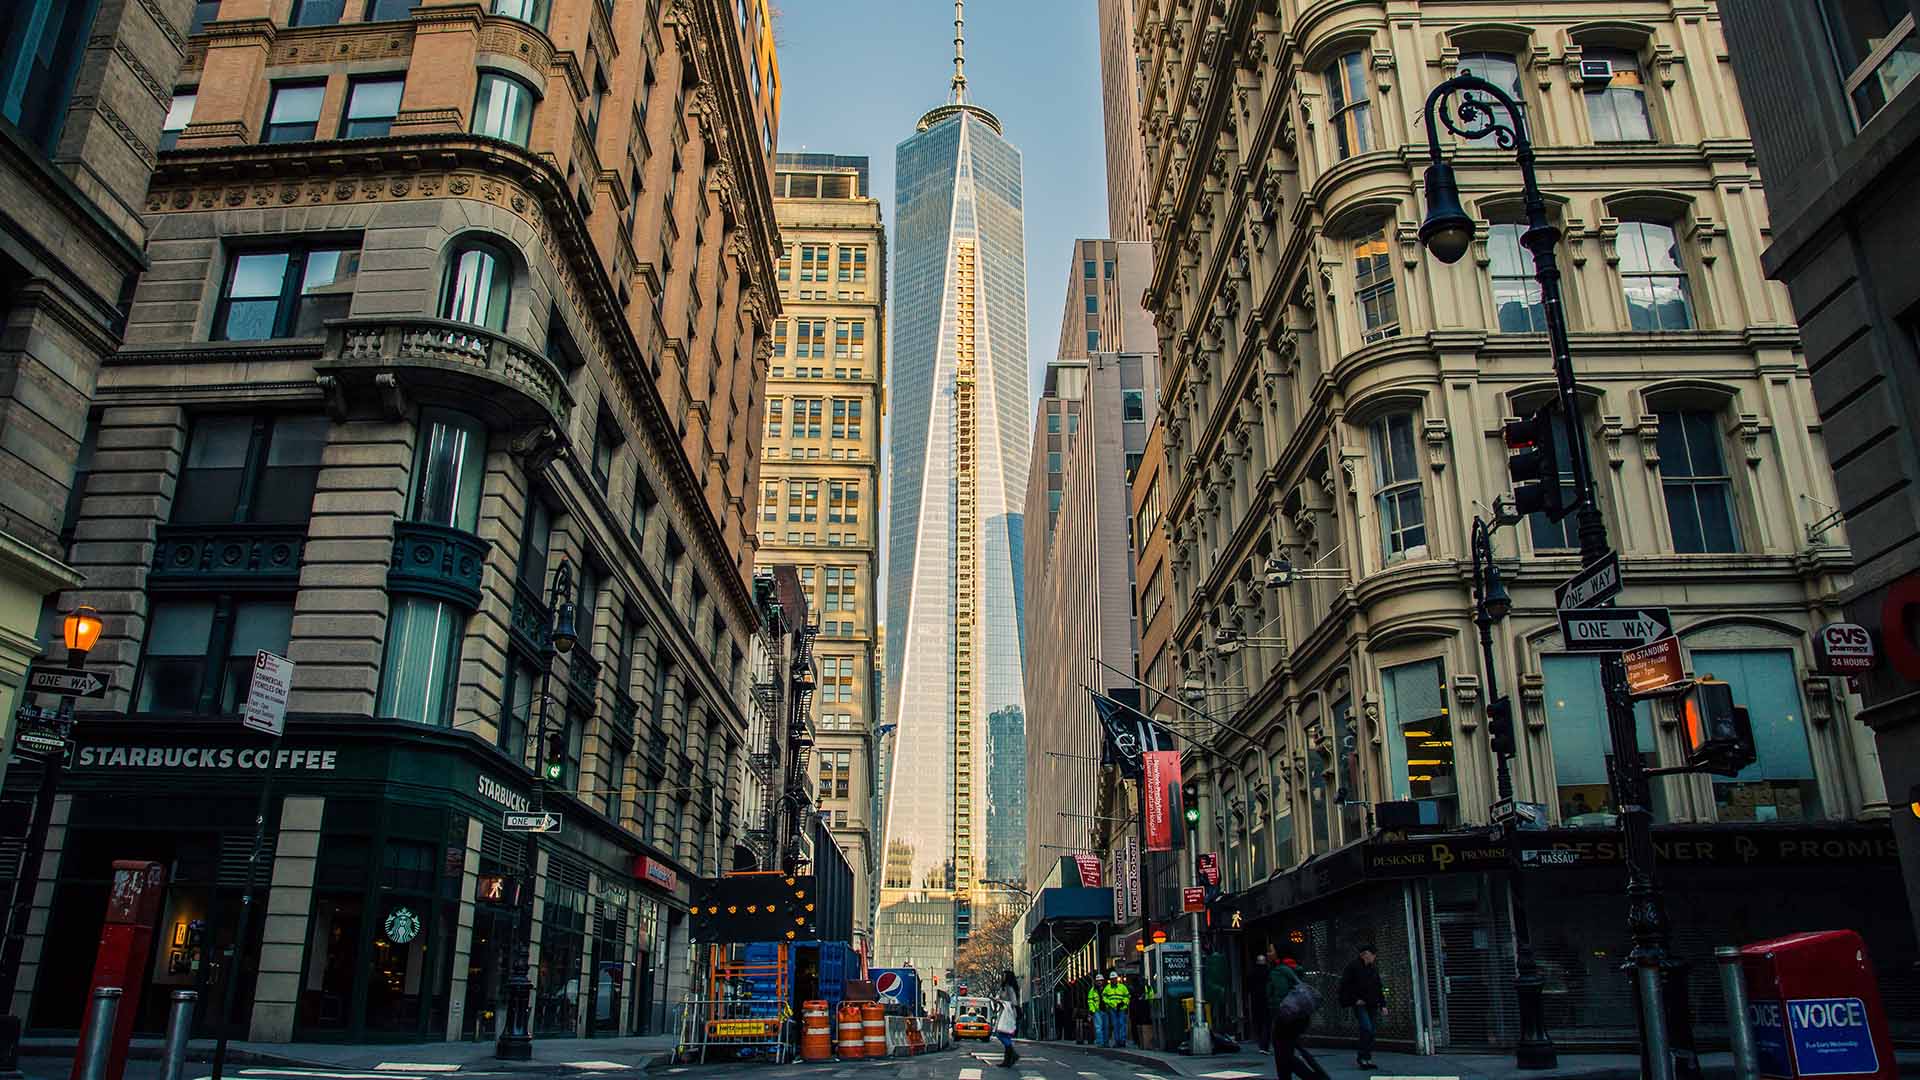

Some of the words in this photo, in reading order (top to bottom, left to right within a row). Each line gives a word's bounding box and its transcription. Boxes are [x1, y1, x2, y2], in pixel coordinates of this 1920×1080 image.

[1565, 586, 1585, 609] ONE
[1590, 568, 1611, 594] WAY
[1578, 622, 1611, 638] ONE
[1622, 621, 1655, 637] WAY
[1826, 627, 1867, 645] CVS
[257, 652, 266, 668] 3
[1625, 652, 1637, 663] NO
[1637, 642, 1670, 660] STANDING
[1831, 657, 1842, 666] 24
[1843, 657, 1871, 667] HOURS
[38, 674, 62, 686] ONE
[71, 678, 96, 690] WAY
[79, 746, 235, 768] STARBUCKS
[237, 749, 337, 770] COFFEE
[478, 775, 526, 813] STARBUCKS
[512, 817, 528, 826] ONE
[1129, 837, 1137, 879] Roberts
[1373, 854, 1425, 866] DESIGNER
[1541, 854, 1574, 864] NASSAU
[1750, 1004, 1782, 1027] OICE
[1795, 1002, 1863, 1028] VOICE
